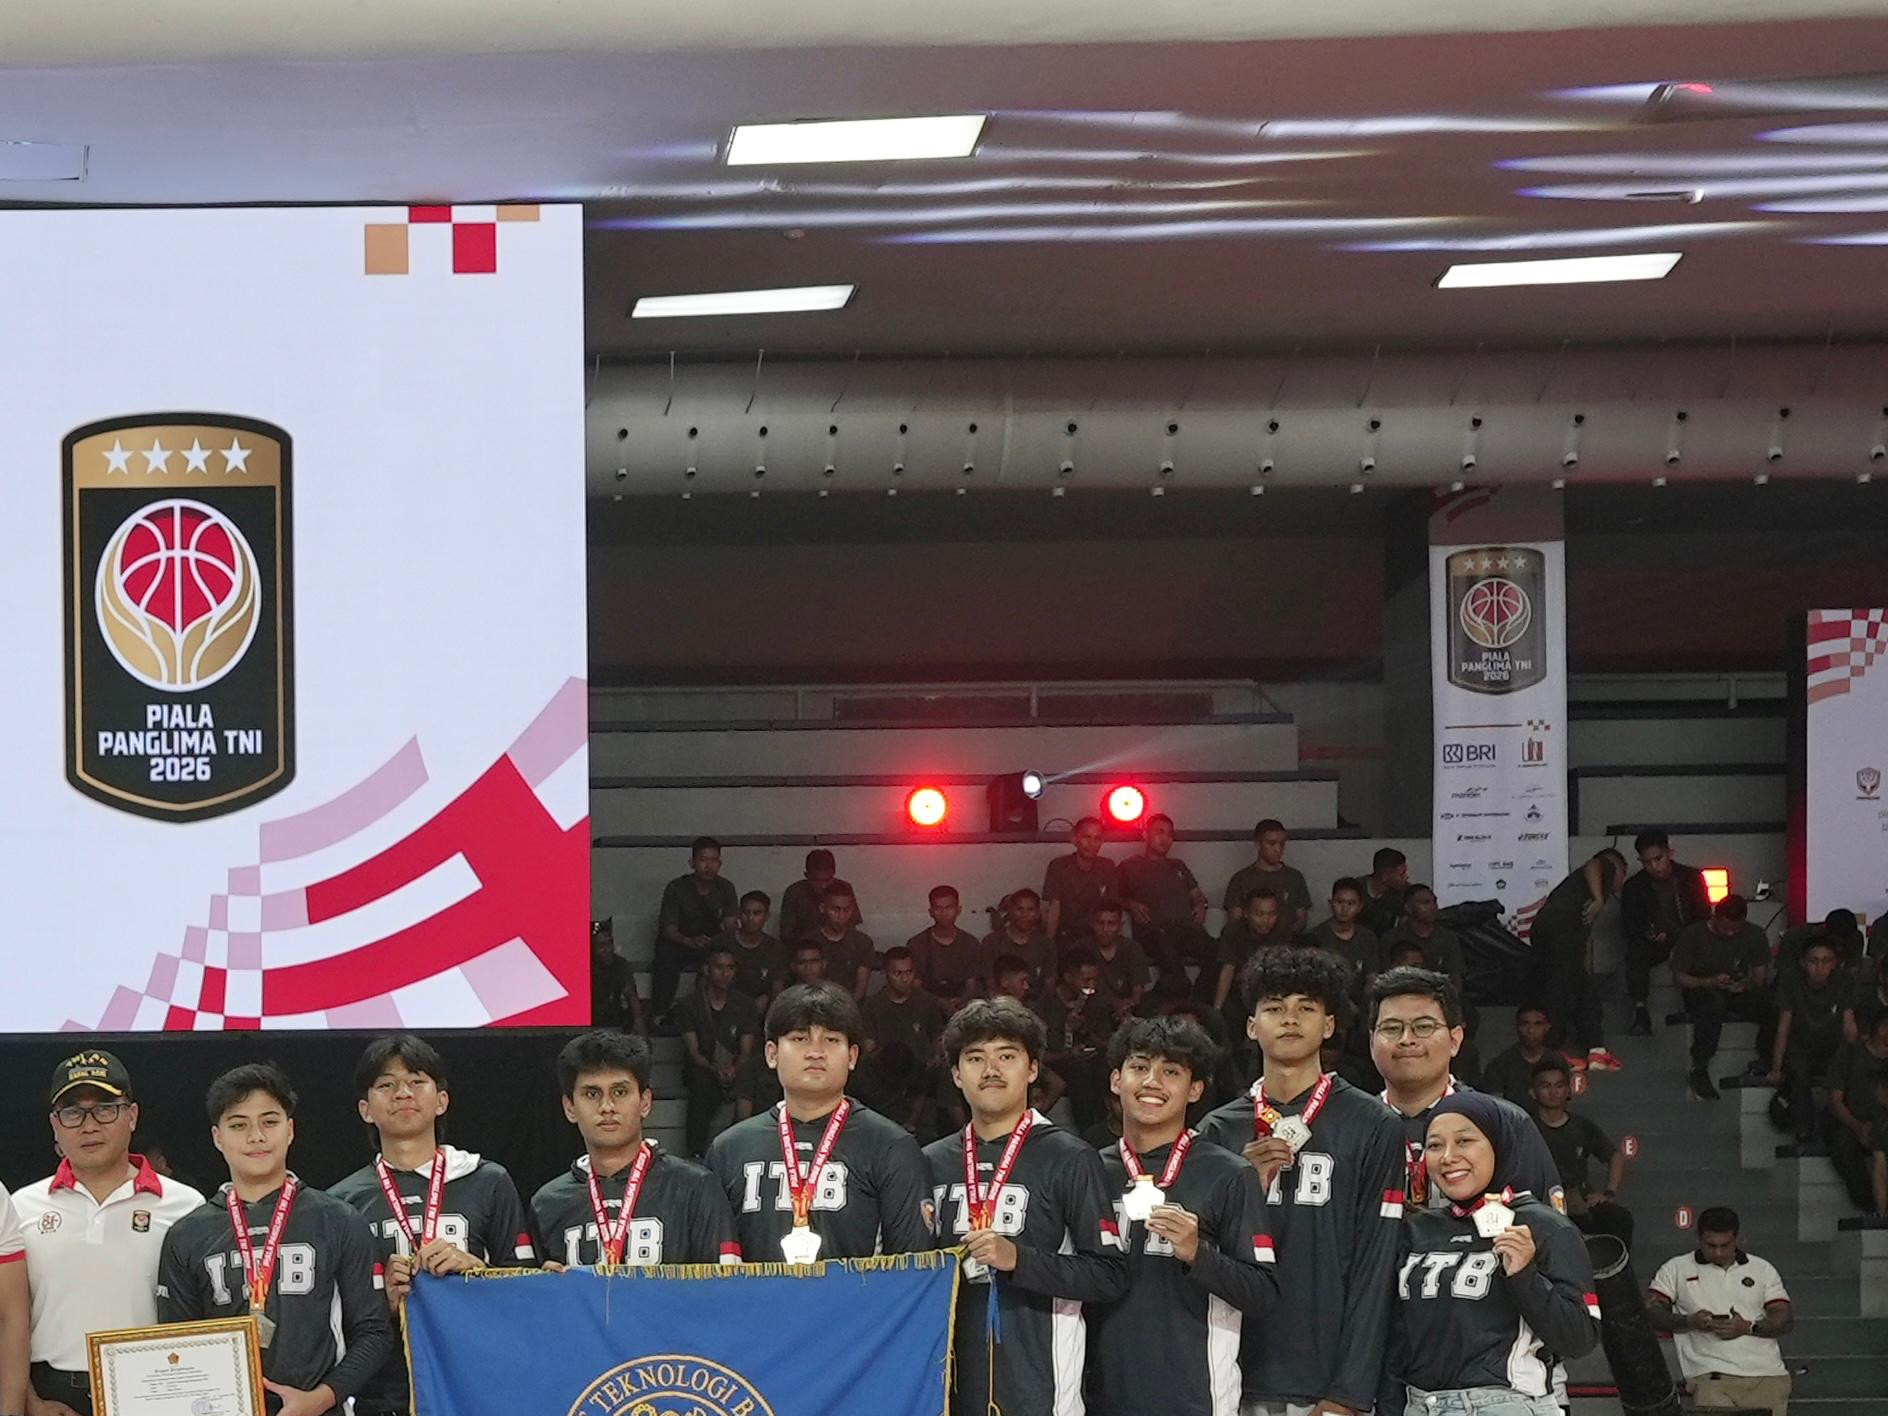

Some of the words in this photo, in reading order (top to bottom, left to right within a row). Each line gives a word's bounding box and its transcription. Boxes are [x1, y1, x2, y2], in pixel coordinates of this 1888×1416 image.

[1461, 660, 1512, 672] PANGLIMA
[1515, 660, 1532, 671] TNI
[1481, 651, 1510, 661] PIALA
[146, 704, 214, 729] PIALA
[98, 730, 217, 756] PANGLIMA
[223, 730, 262, 754] TNI
[1466, 744, 1496, 761] BRI
[149, 756, 212, 782] 2026
[742, 1161, 849, 1213] ITB
[589, 1363, 739, 1414] TEKNOLOGI
